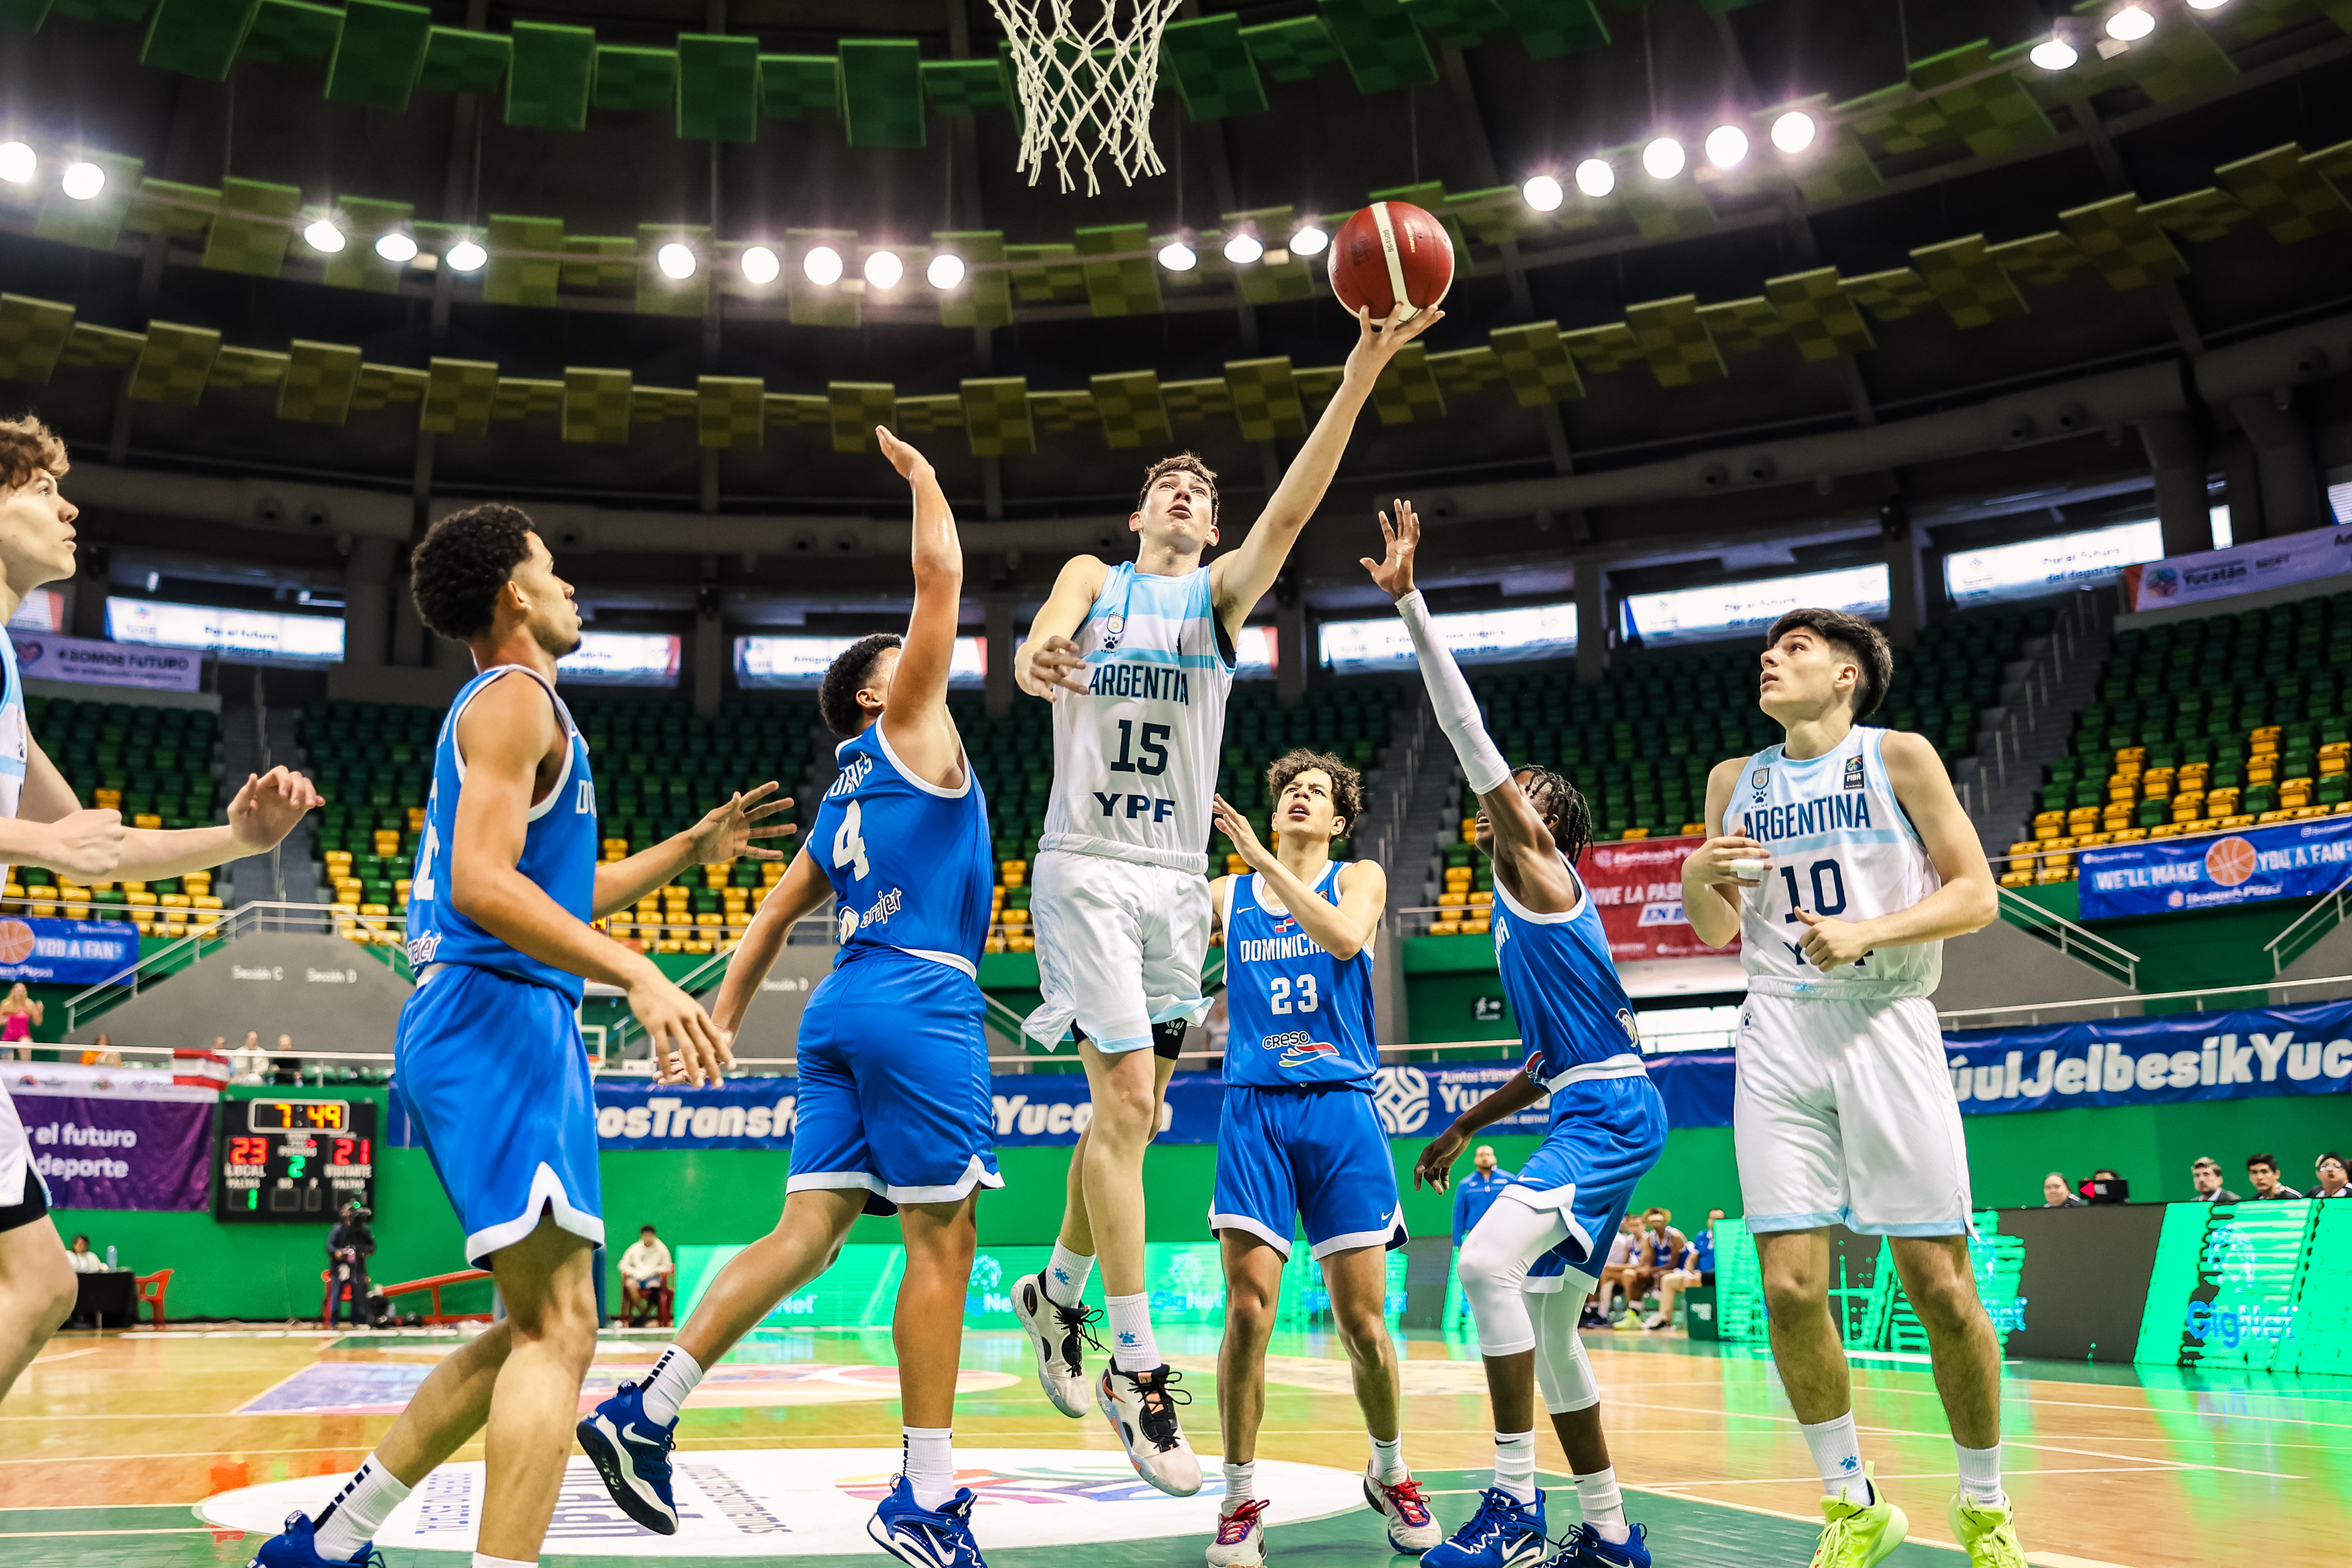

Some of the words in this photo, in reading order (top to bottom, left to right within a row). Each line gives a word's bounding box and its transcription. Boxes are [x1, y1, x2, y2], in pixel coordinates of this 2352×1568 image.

[1383, 229, 1395, 253] BG4500
[1111, 719, 1170, 776] 15
[1846, 773, 1861, 782] FIBA
[1092, 792, 1176, 823] YPF
[1744, 792, 1871, 842] ARGENTINA
[833, 799, 870, 882] 4
[1624, 885, 1645, 903] LA
[1780, 858, 1847, 924] 10
[860, 887, 902, 929] arajet
[1240, 933, 1326, 963] DOMINICA
[271, 965, 284, 982] C
[1270, 974, 1318, 1015] 23
[595, 1095, 797, 1139] osTransf
[35, 1121, 59, 1146] el
[61, 1121, 137, 1149] futuro
[230, 1137, 268, 1165] 23
[334, 1138, 370, 1165] 21
[287, 1154, 306, 1178] 2
[36, 1152, 129, 1182] deporte
[768, 1293, 819, 1318] Net
[2186, 1300, 2299, 1348] GigNet
